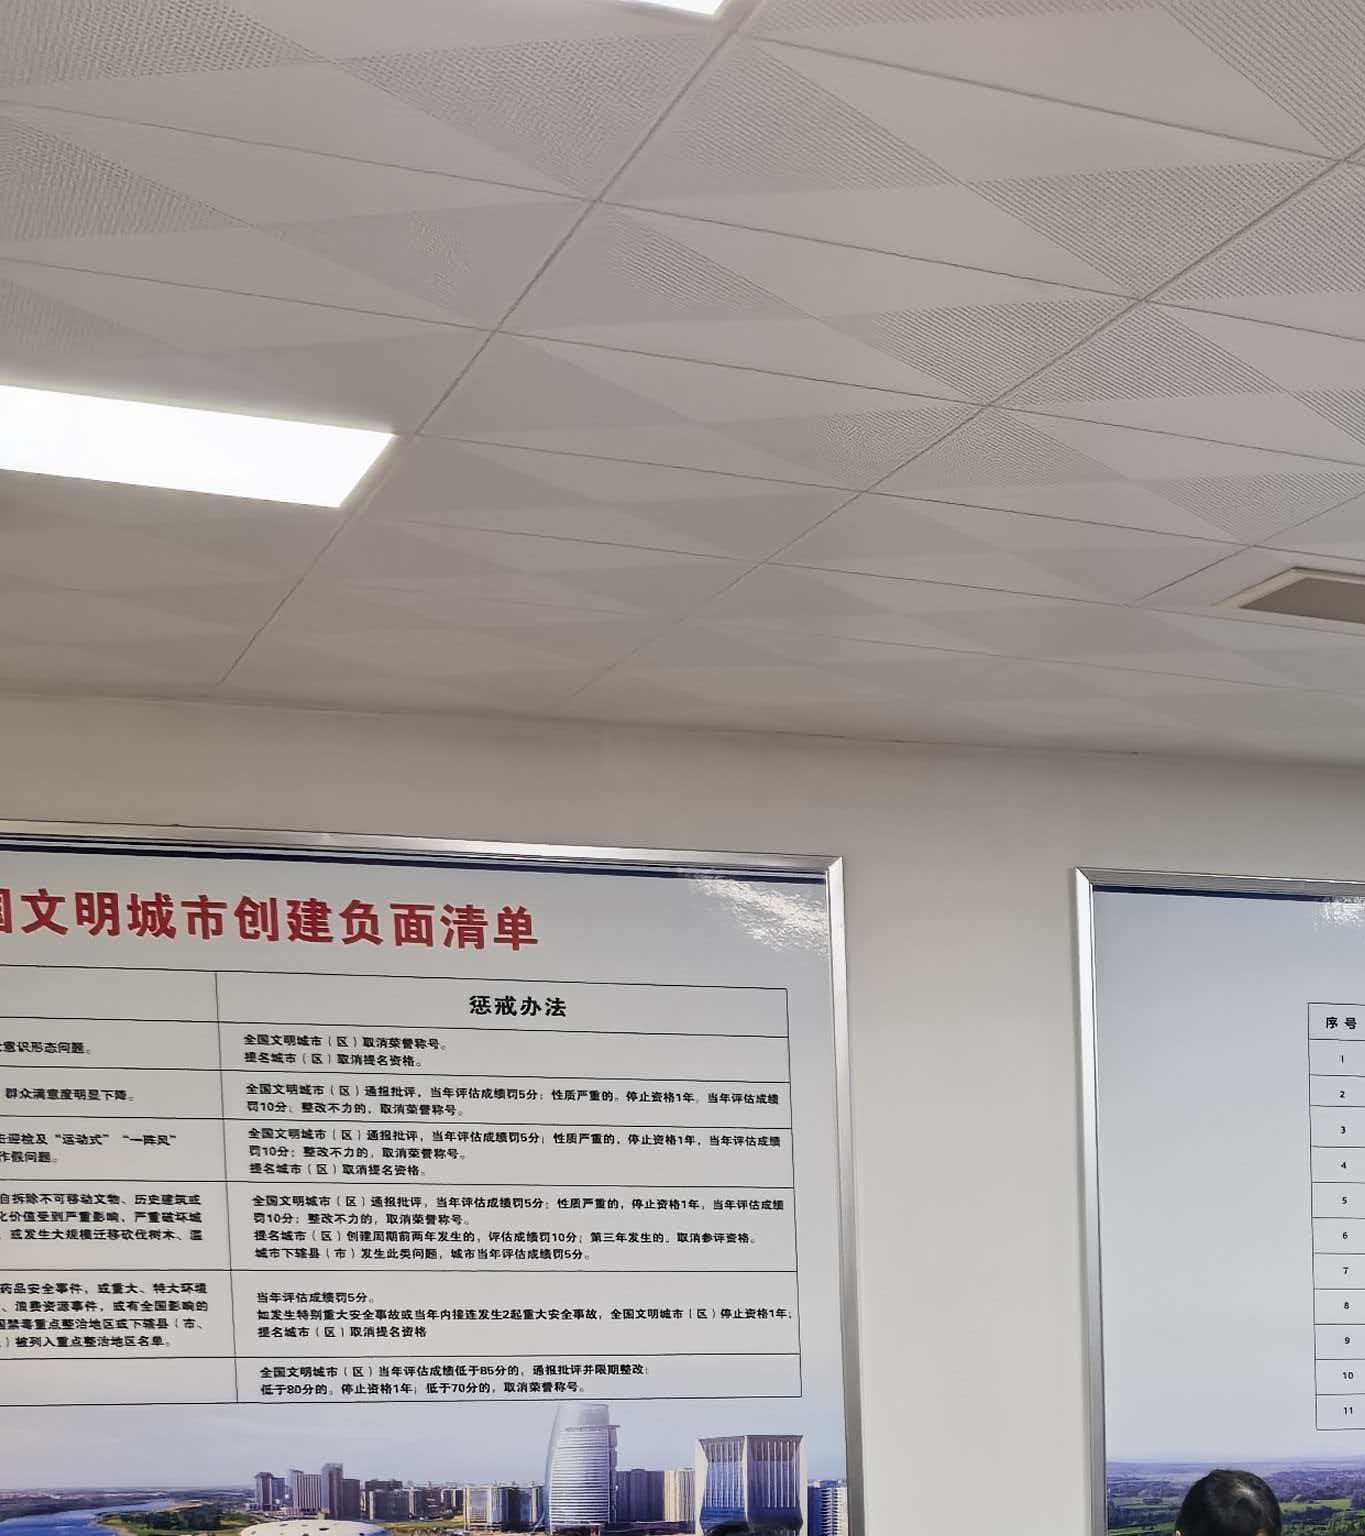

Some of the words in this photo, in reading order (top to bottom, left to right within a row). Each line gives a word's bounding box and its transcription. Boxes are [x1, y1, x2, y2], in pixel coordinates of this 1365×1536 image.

[0, 887, 539, 951] 文明城市创建负面清单
[468, 994, 568, 1018] 惩戒办法
[1325, 1016, 1357, 1030] 序号
[0, 1041, 91, 1055] 意识形态问题。
